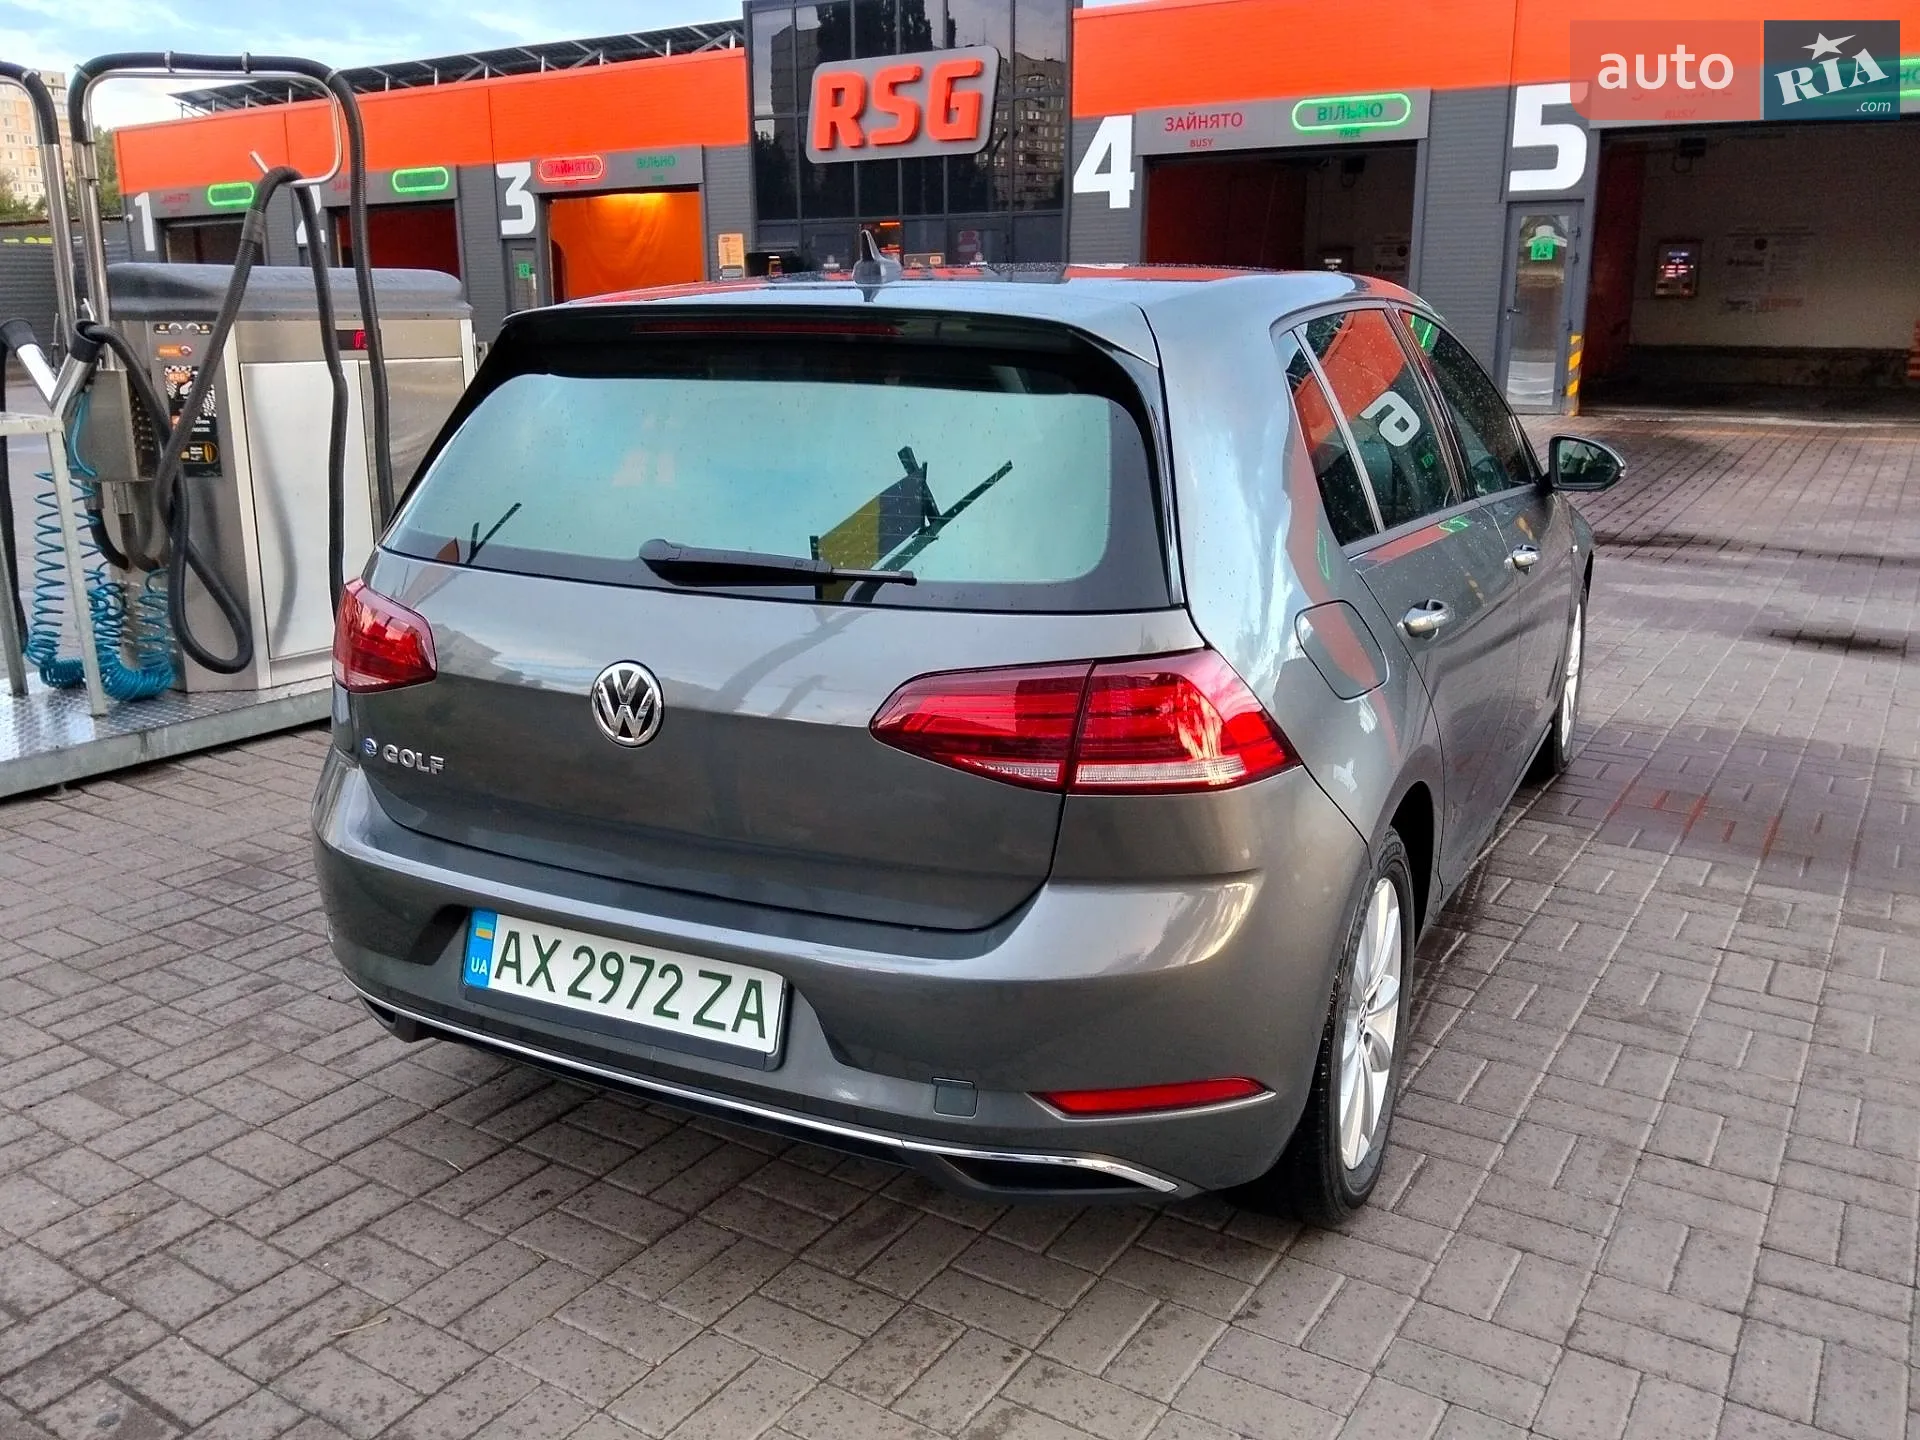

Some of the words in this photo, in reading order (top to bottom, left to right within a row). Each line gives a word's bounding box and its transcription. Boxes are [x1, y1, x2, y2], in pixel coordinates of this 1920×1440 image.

[813, 59, 984, 150] RSG
[1165, 111, 1243, 132] ЗАЙНЯТО
[1317, 102, 1383, 122] ВІЛЬНО
[1072, 114, 1136, 209] 4
[1190, 138, 1214, 149] BUSY
[1509, 82, 1588, 192] 5
[134, 191, 156, 252] 1
[496, 161, 536, 236] 3
[382, 743, 446, 775] GOLF
[470, 957, 488, 975] UA
[494, 930, 562, 993] AX
[567, 945, 684, 1020] 2972
[693, 969, 766, 1039] ZA
